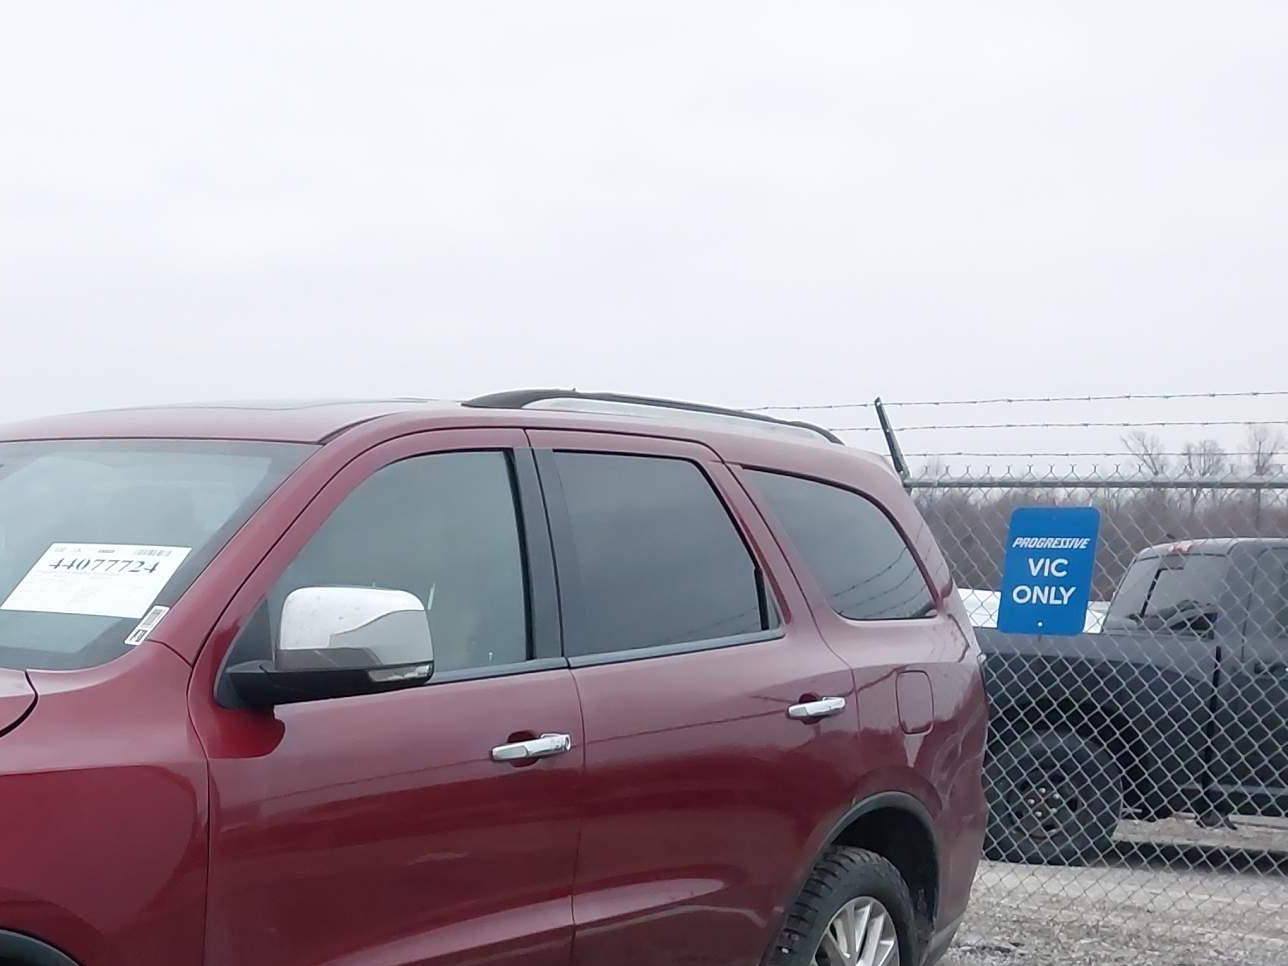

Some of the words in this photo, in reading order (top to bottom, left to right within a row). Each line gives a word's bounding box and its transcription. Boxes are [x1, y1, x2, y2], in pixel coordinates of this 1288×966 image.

[1012, 537, 1091, 549] PROGRESSIVE
[49, 558, 160, 573] 44077724
[1028, 558, 1069, 577] VIC
[1012, 585, 1076, 605] ONLY
